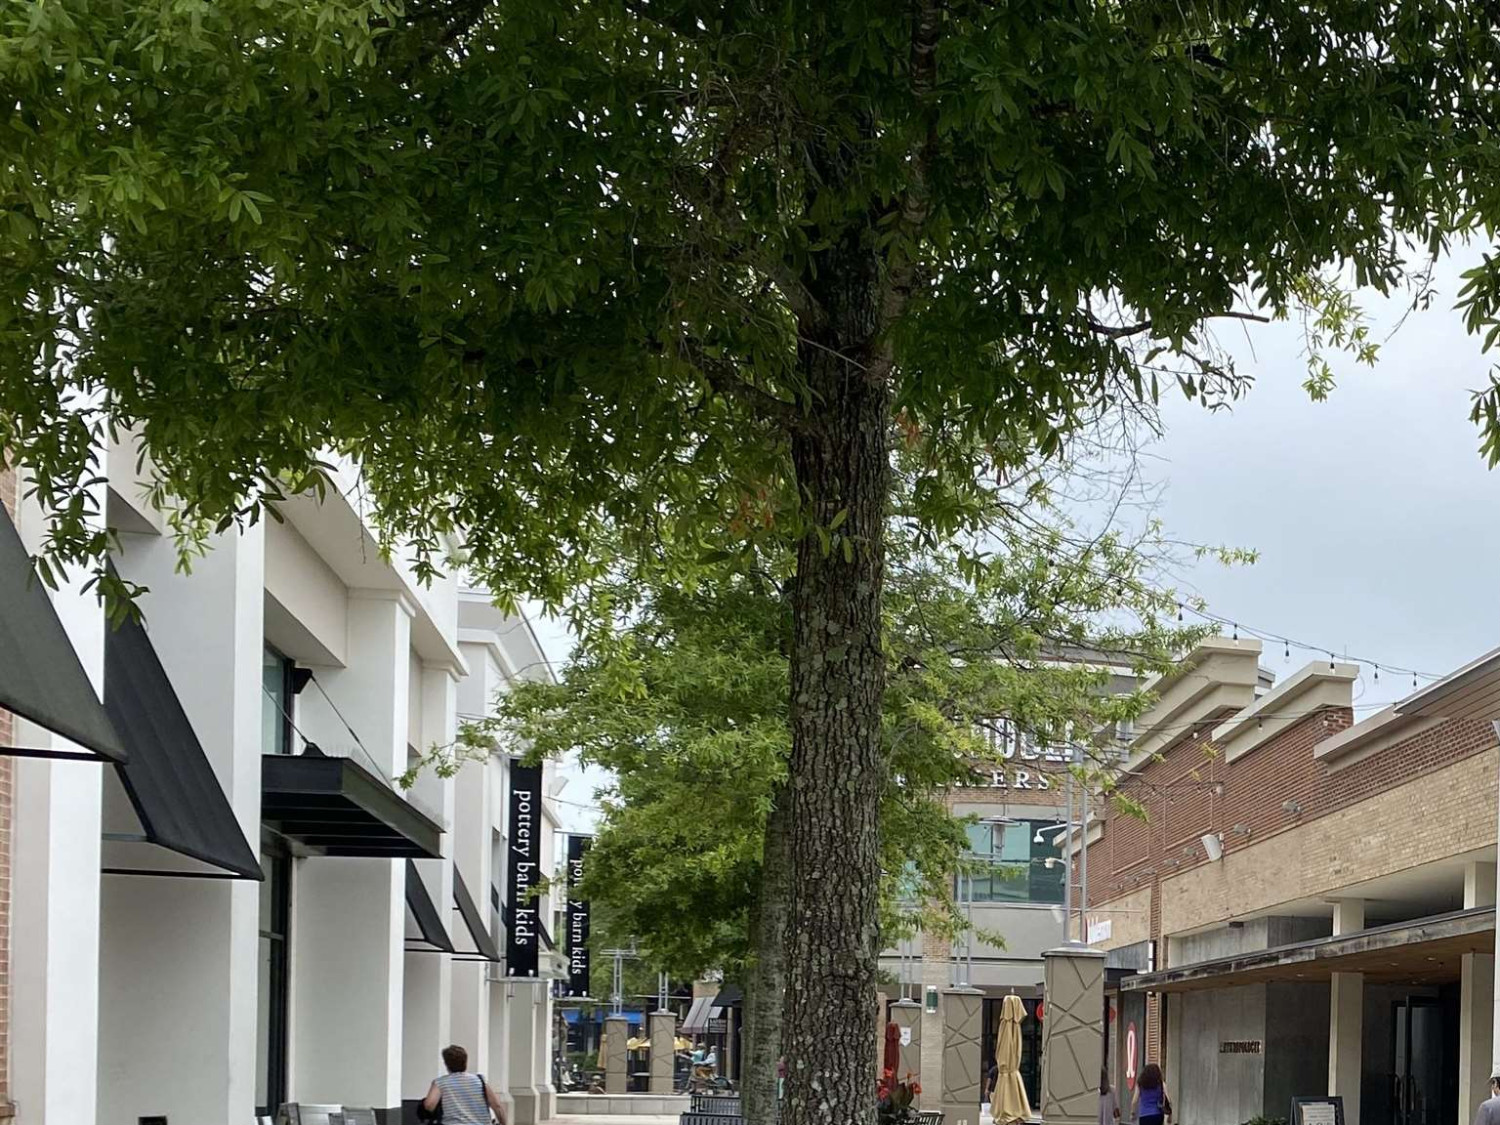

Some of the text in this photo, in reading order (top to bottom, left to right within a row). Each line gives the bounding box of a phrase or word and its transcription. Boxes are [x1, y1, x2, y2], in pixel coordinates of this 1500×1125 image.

[512, 790, 536, 946] pottery barn kids
[572, 912, 588, 942] barn
[572, 946, 587, 974] kids
